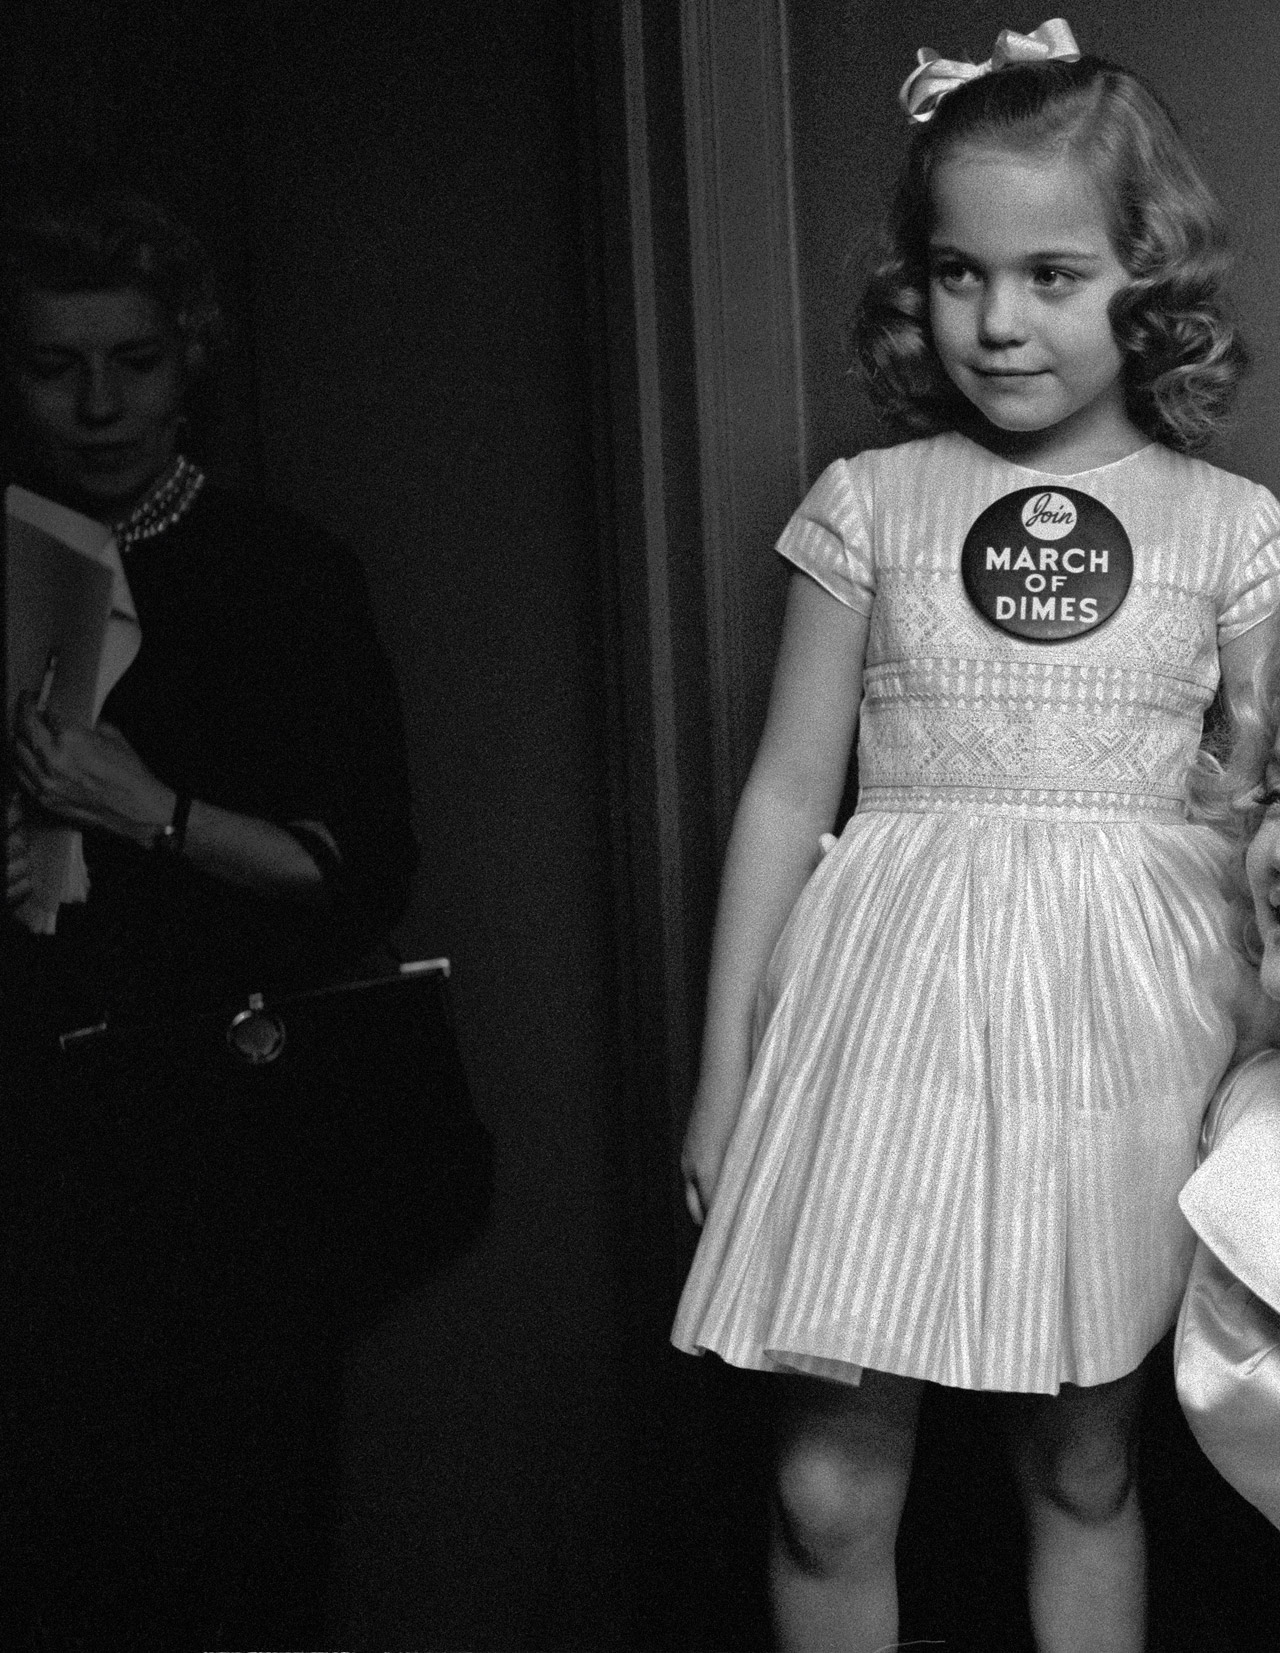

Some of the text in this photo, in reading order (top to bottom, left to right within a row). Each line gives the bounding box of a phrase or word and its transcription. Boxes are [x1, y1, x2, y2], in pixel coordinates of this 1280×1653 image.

[1025, 493, 1074, 527] Join
[986, 546, 1109, 574] MARCH
[1025, 573, 1068, 592] OF
[995, 596, 1099, 623] DIMES
